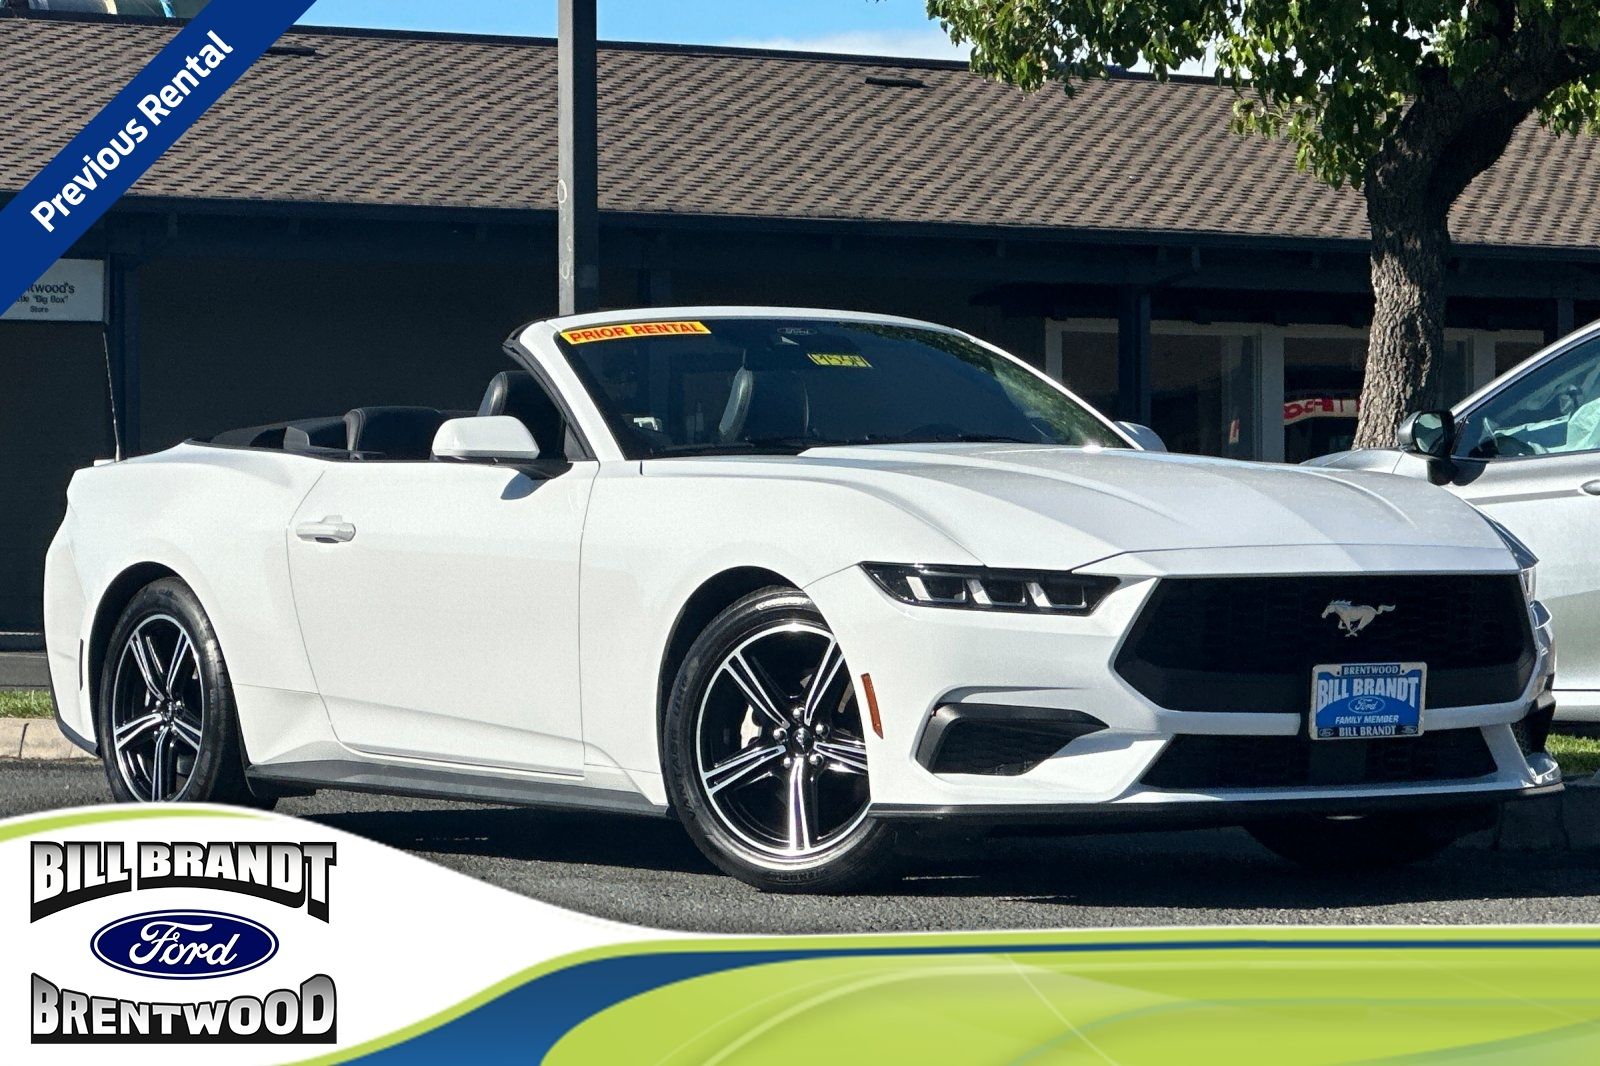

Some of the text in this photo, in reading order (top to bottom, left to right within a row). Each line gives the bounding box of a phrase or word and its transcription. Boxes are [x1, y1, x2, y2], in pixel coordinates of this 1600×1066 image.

[568, 322, 705, 342] PRIOR RENTAL
[1343, 665, 1399, 675] BRENTWOOD
[1317, 677, 1419, 714] BILL BRANDT
[1354, 698, 1378, 711] Ford
[1335, 715, 1399, 725] FAMILY MEMBER
[1339, 727, 1358, 737] BILL
[1360, 726, 1397, 736] BRANDT
